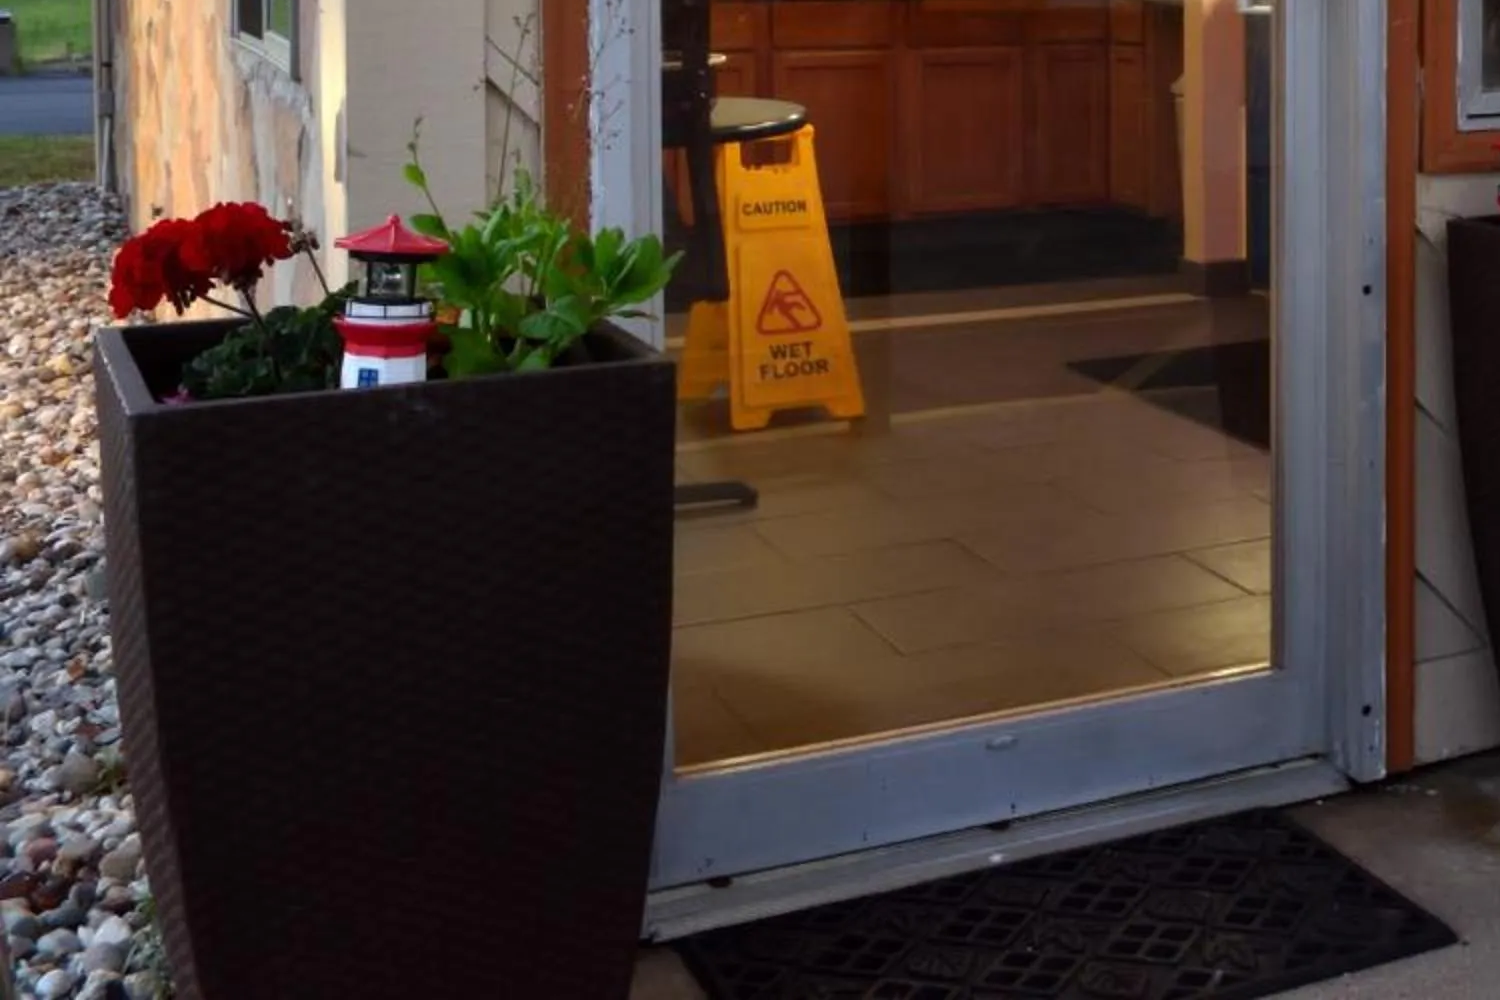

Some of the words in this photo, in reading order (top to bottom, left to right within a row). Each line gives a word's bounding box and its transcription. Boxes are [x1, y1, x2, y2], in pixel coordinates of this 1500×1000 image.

[742, 200, 807, 217] CAUTION
[769, 341, 813, 360] WET
[759, 359, 829, 381] FLOOR
